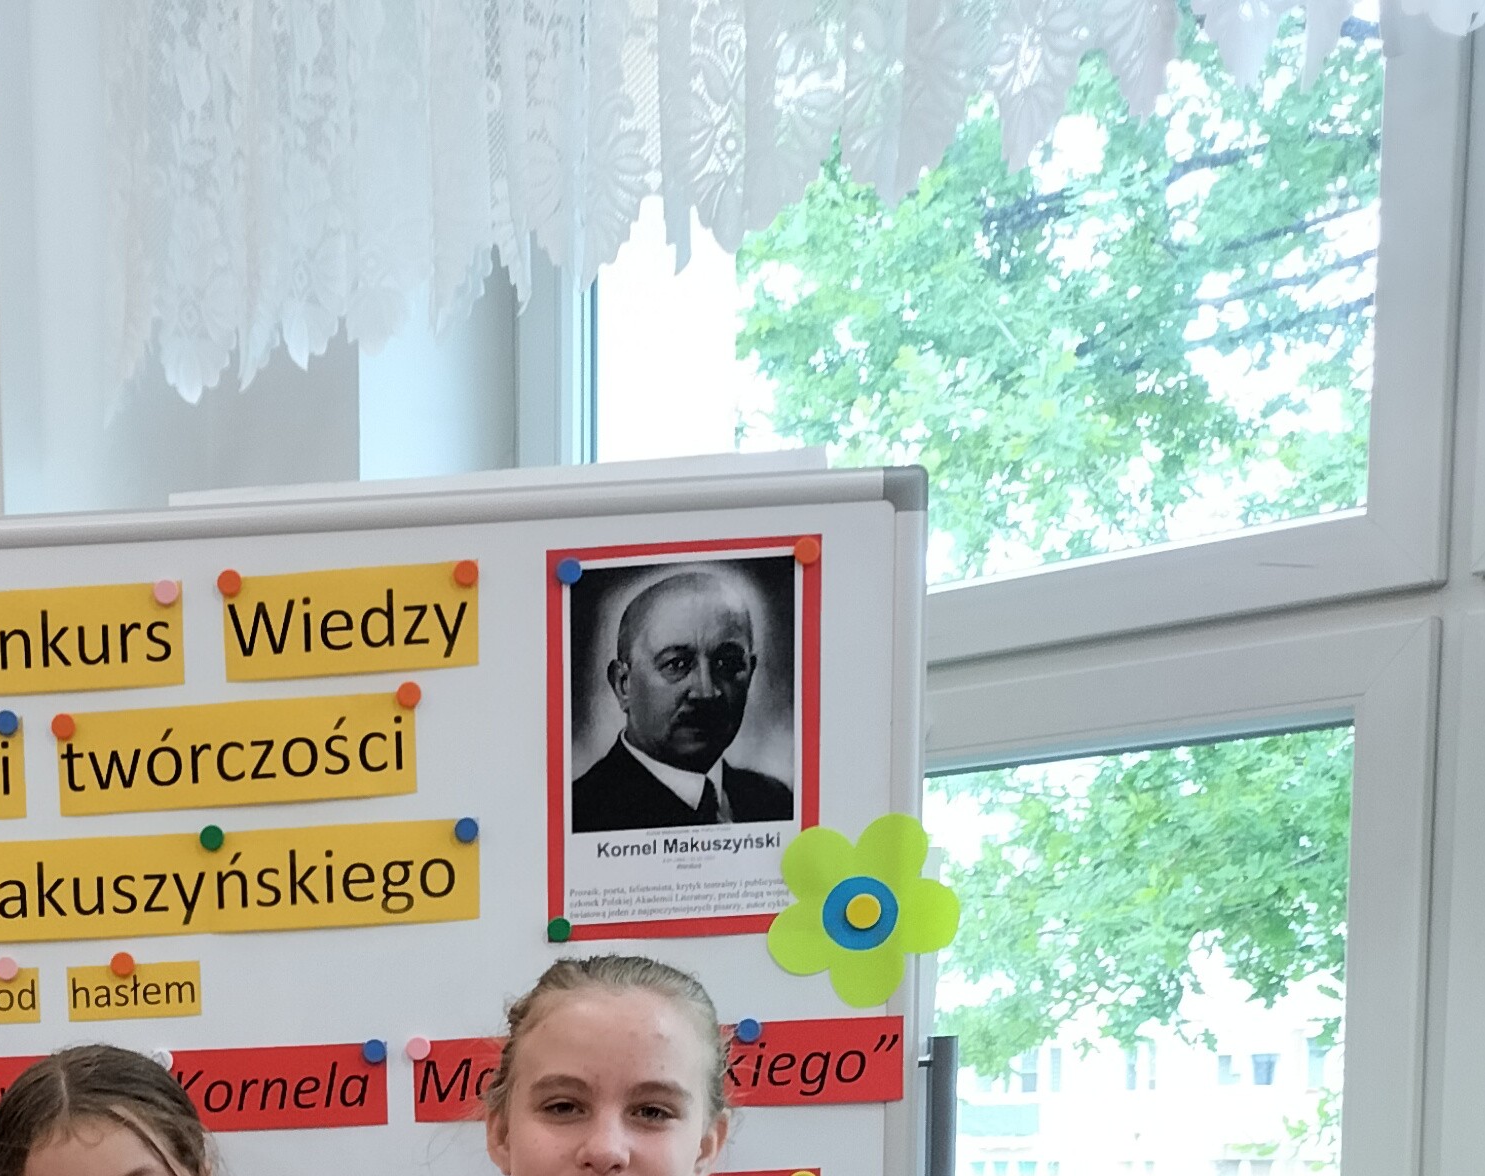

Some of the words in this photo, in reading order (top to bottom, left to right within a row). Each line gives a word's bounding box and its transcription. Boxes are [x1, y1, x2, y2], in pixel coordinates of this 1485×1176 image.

[227, 590, 469, 660] Wiedzy
[0, 742, 12, 796] i
[62, 715, 406, 792] twórczości
[596, 839, 657, 858] Kornel
[663, 832, 781, 855] Makuszyński
[70, 975, 196, 1011] hasłem
